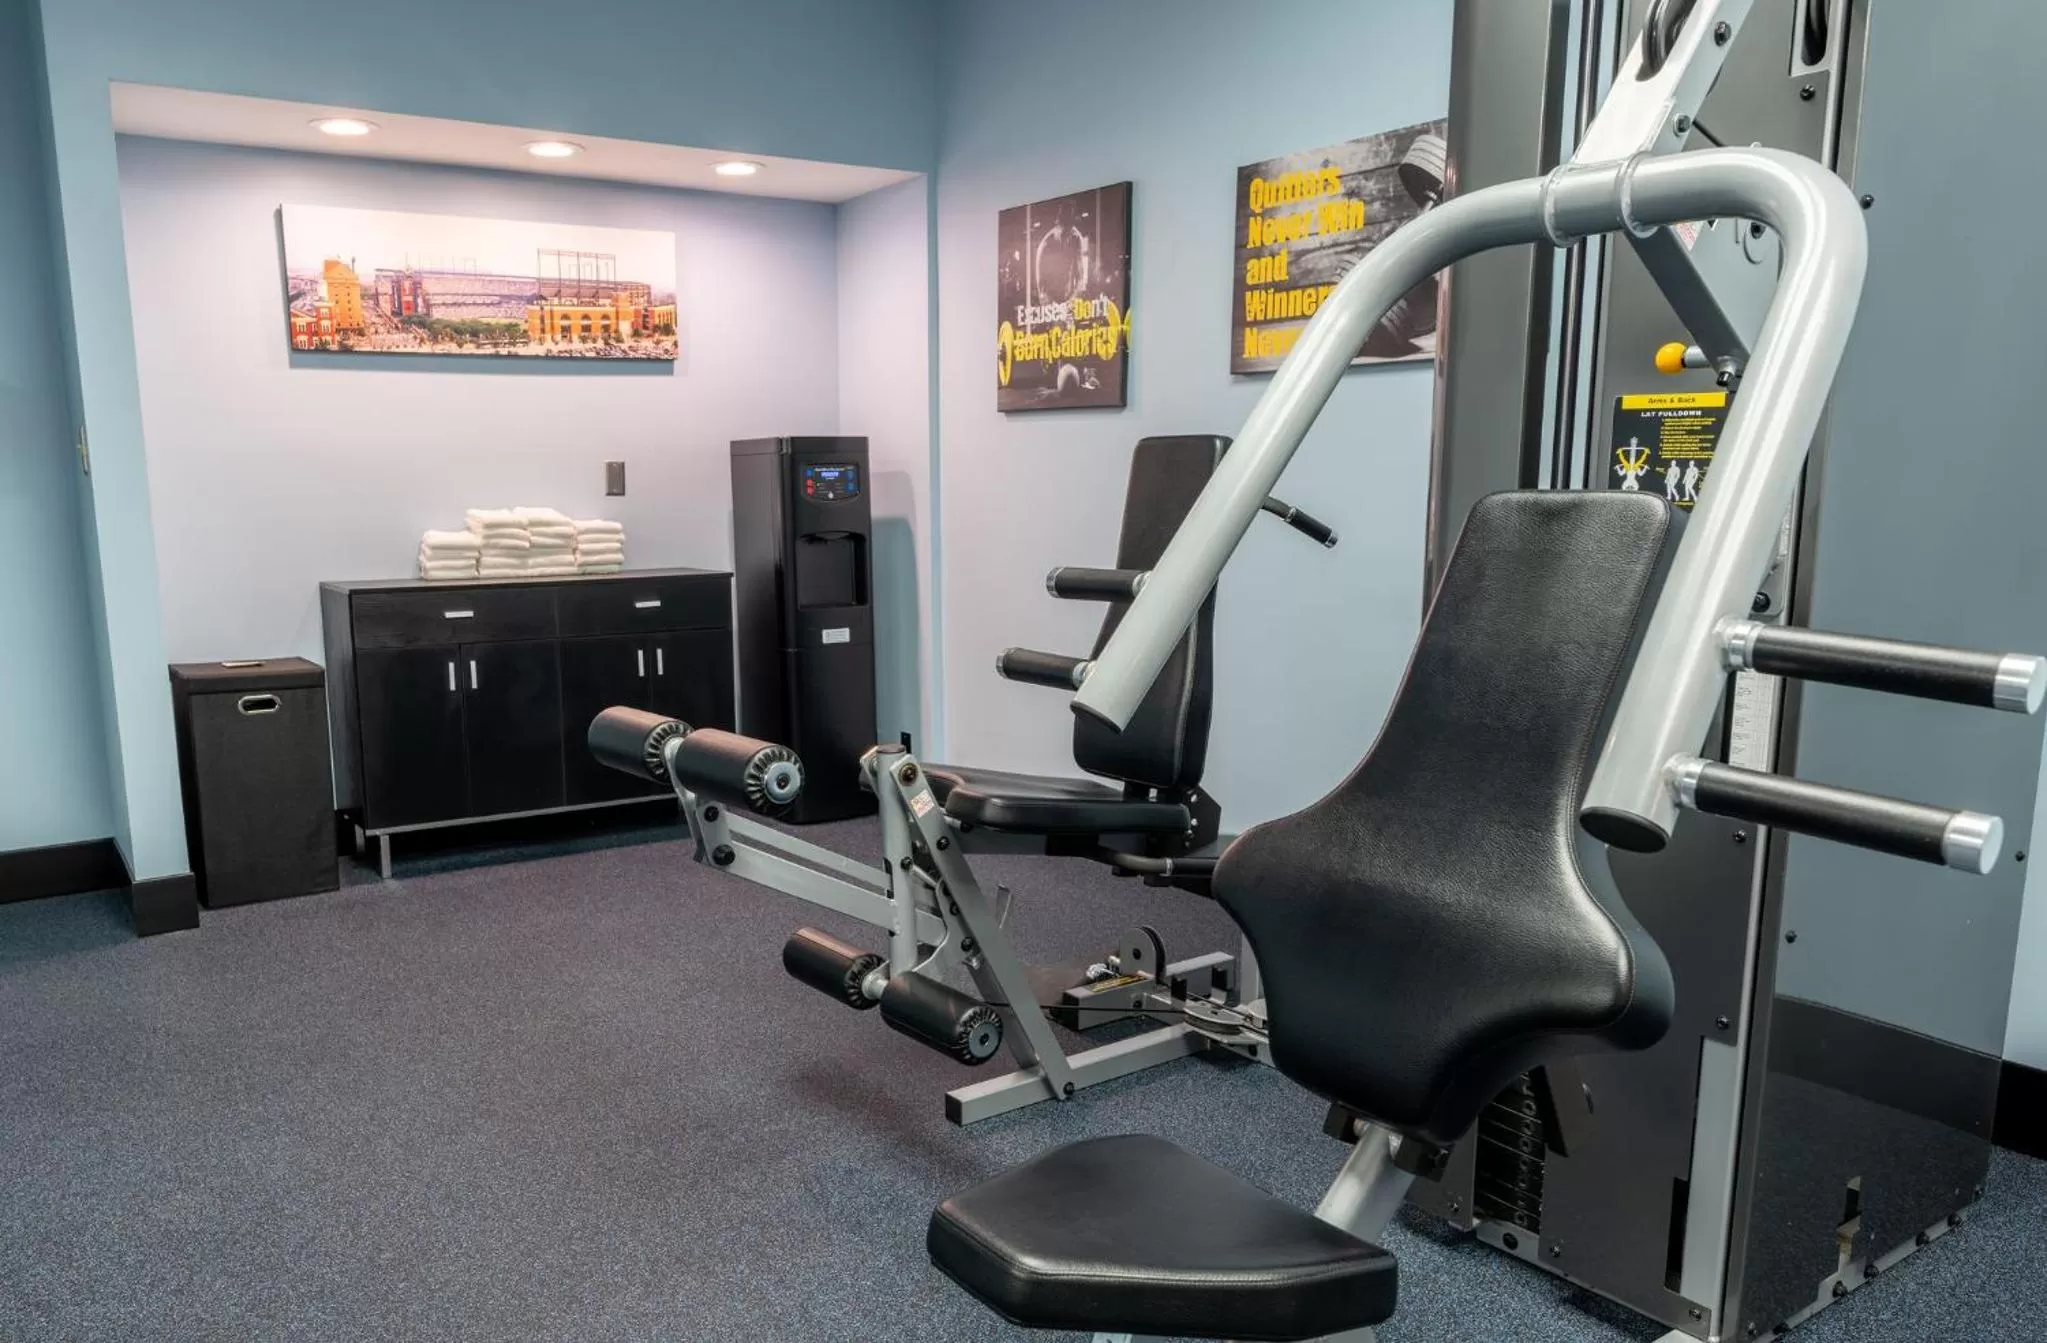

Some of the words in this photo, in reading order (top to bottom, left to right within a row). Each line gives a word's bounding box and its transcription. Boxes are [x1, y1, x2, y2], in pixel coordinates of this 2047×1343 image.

[1249, 167, 1341, 213] Quitters
[1246, 211, 1313, 248] Never
[1317, 199, 1364, 235] Win
[1246, 248, 1289, 285] and
[1017, 301, 1069, 326] Excuses
[1245, 284, 1337, 321] Winner
